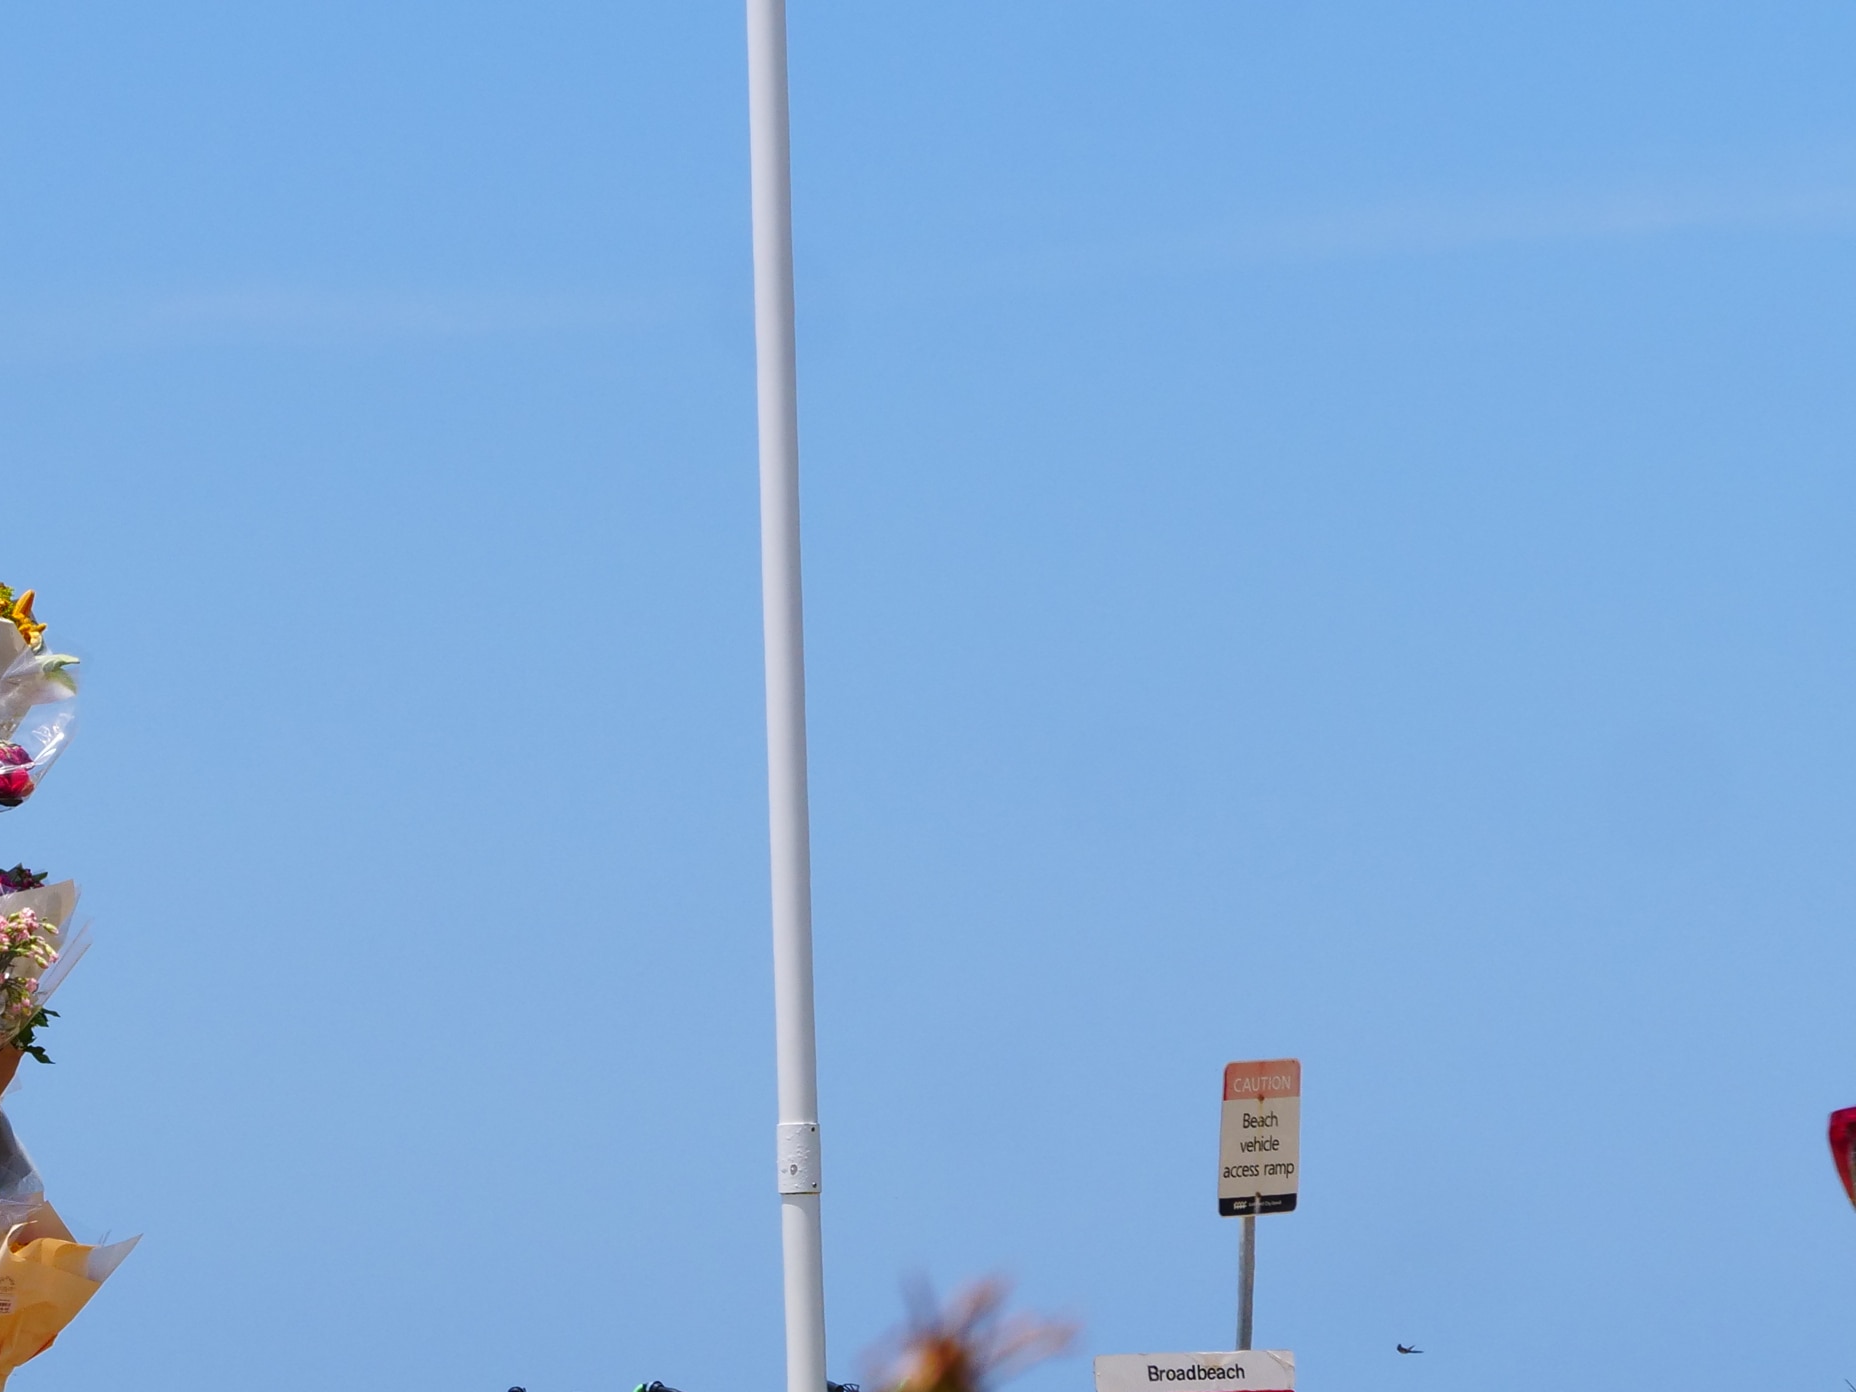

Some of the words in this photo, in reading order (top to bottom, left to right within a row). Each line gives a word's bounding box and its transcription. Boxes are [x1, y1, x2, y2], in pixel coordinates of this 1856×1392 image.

[1233, 1075, 1292, 1093] CAUTION
[1242, 1111, 1279, 1129] Beach
[1240, 1135, 1281, 1153] vehicle
[1223, 1164, 1260, 1179] access
[1263, 1161, 1295, 1179] ramp
[1147, 1363, 1246, 1382] Broadbeach
